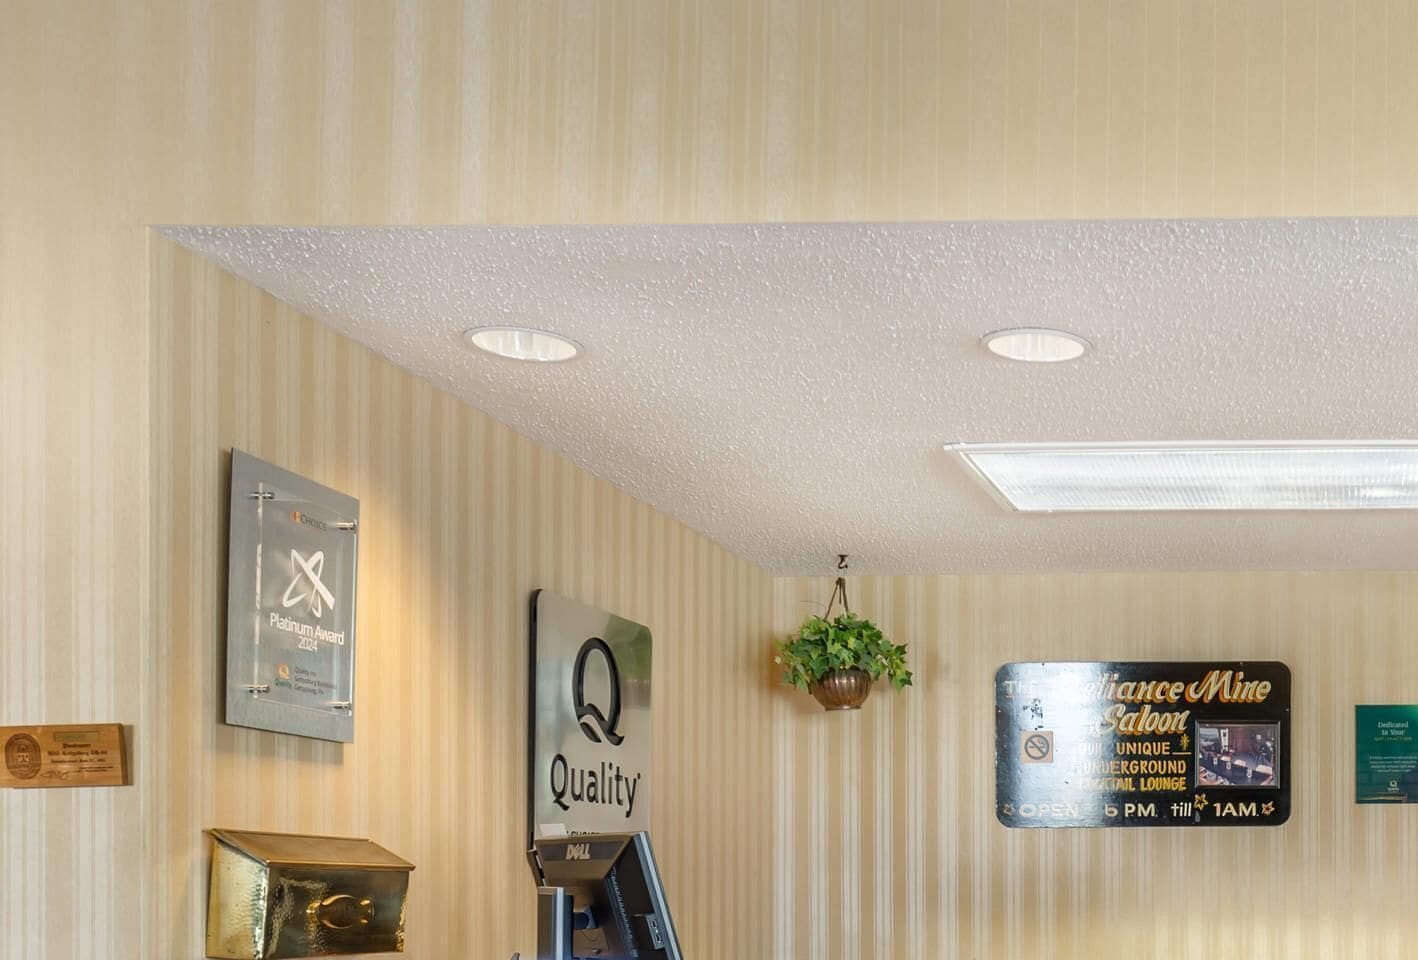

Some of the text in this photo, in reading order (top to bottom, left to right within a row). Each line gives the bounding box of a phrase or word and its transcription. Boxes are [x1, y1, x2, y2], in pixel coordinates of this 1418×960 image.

[269, 611, 345, 647] Platinum Award
[297, 635, 319, 653] 2024
[1078, 671, 1186, 704] eliance
[1185, 669, 1272, 704] Mine
[1097, 703, 1190, 736] Saloon
[1116, 741, 1170, 756] UNIQUE
[1082, 759, 1187, 775] UNDERGROUND
[549, 753, 635, 818] Quality
[1140, 777, 1187, 792] LOUNGE
[1019, 803, 1078, 817] OPEN
[1170, 802, 1192, 817] till
[565, 842, 591, 861] DELL
